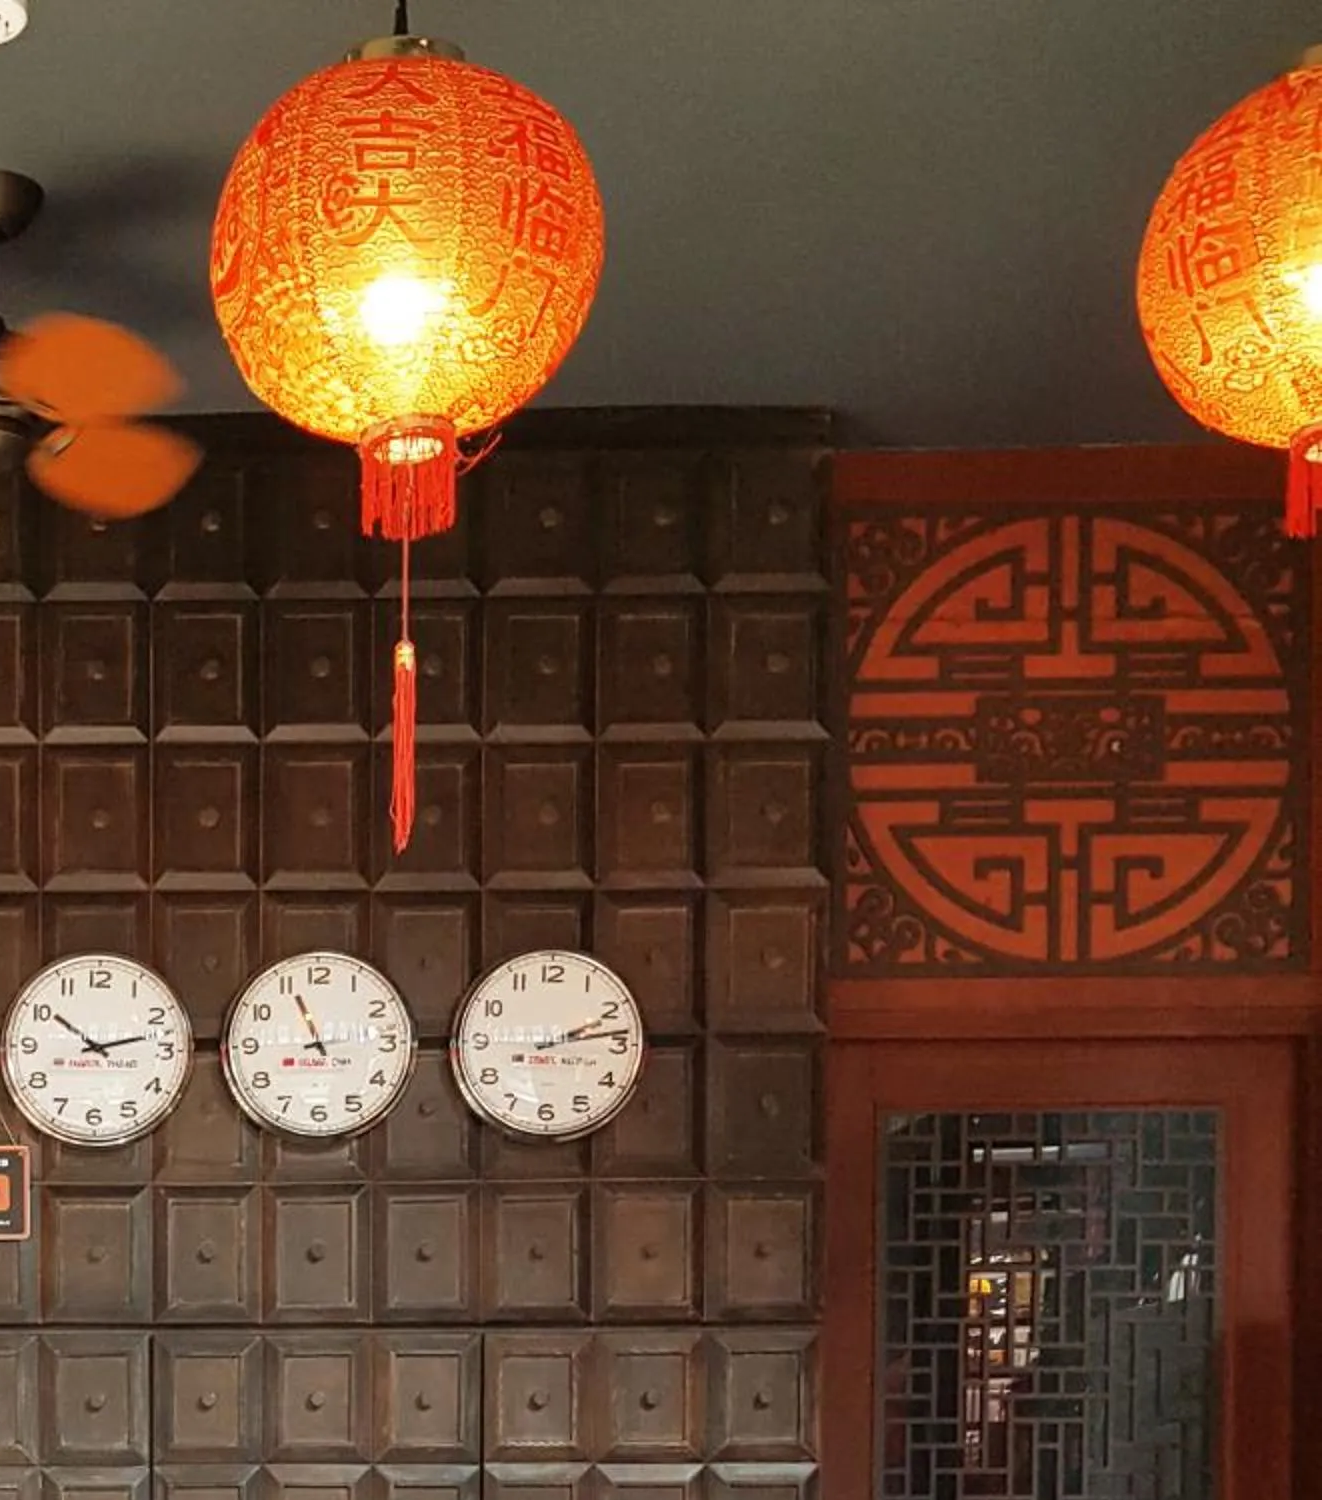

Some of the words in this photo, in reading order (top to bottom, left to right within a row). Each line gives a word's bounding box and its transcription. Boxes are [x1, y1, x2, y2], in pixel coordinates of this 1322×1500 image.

[90, 970, 112, 988] 12
[308, 967, 330, 984] 12
[513, 973, 526, 991] 11
[542, 965, 564, 983] 12
[62, 978, 73, 995] 11
[131, 980, 137, 998] 1
[280, 976, 292, 994] 11
[351, 975, 357, 992] 1
[585, 976, 591, 992] 1
[34, 1004, 51, 1021] 10
[148, 1008, 165, 1025] 2
[254, 1004, 271, 1021] 10
[369, 1000, 386, 1018] 2
[485, 1000, 502, 1017] 10
[601, 1002, 618, 1019] 2
[21, 1037, 38, 1054] 9
[158, 1043, 174, 1060] 3
[242, 1038, 259, 1054] 9
[378, 1034, 396, 1052] 3
[607, 1034, 627, 1054] 3
[29, 1072, 47, 1088] 8
[252, 1072, 270, 1088] 8
[370, 1070, 386, 1087] 4
[480, 1068, 498, 1084] 8
[598, 1072, 615, 1088] 4
[54, 1098, 68, 1115] 7
[120, 1101, 137, 1118] 5
[277, 1096, 292, 1113] 7
[345, 1095, 362, 1112] 5
[504, 1093, 518, 1111] 7
[572, 1096, 590, 1113] 5
[86, 1108, 102, 1125] 6
[310, 1106, 327, 1122] 6
[537, 1104, 554, 1121] 6
